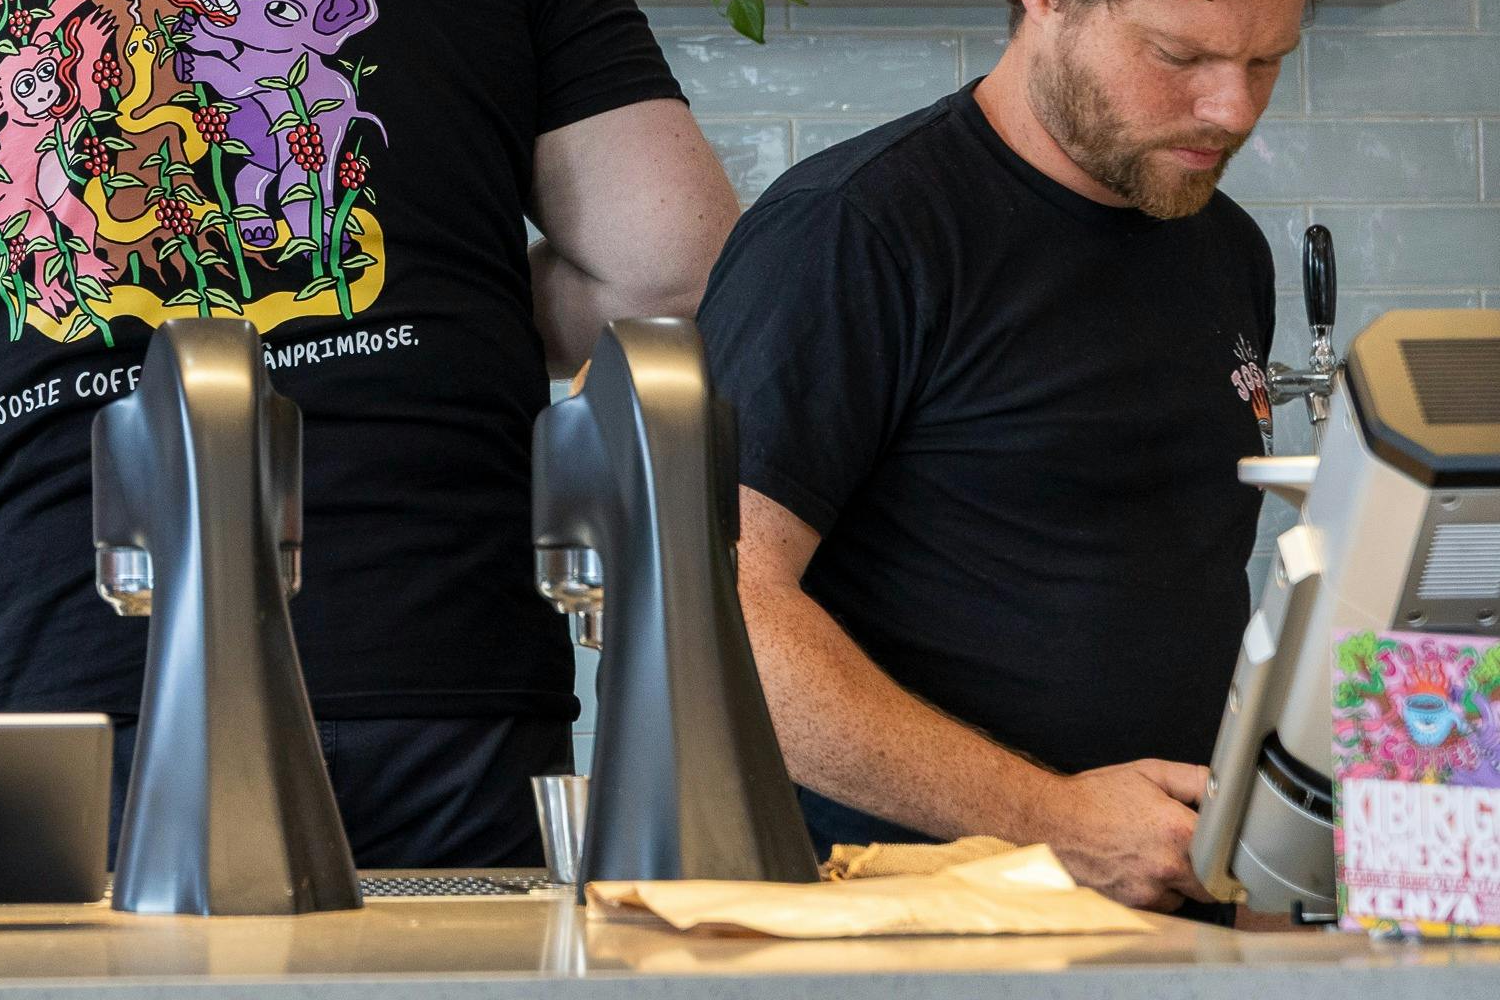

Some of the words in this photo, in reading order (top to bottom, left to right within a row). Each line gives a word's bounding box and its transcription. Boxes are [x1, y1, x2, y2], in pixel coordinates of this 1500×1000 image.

[75, 365, 142, 398] COFF
[1230, 361, 1269, 402] JOSI
[1348, 886, 1484, 925] KENYA
